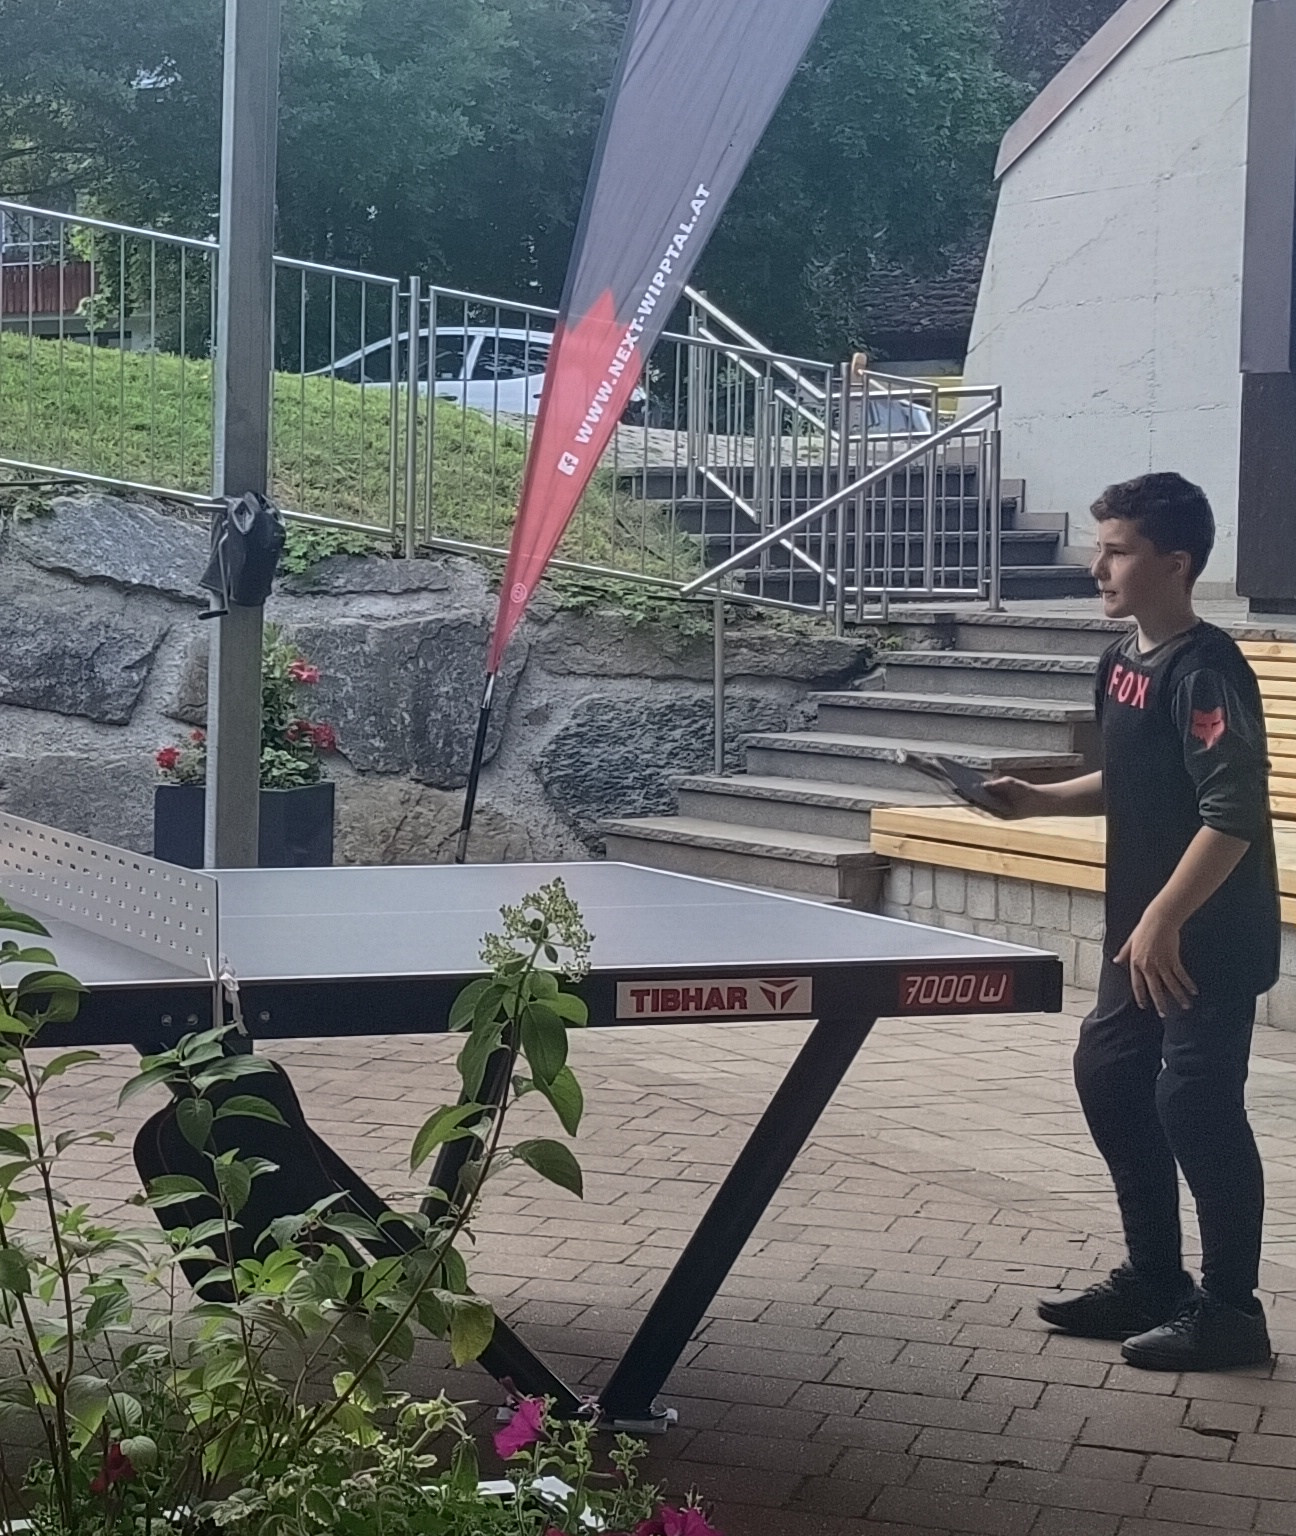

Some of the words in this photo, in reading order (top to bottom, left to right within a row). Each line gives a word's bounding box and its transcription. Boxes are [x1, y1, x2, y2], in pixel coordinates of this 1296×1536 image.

[574, 183, 711, 445] WWW.NEXT-WIPPTAL.AT
[1108, 664, 1150, 709] FOX
[629, 986, 748, 1013] TIBHAR
[906, 975, 976, 1005] 7000
